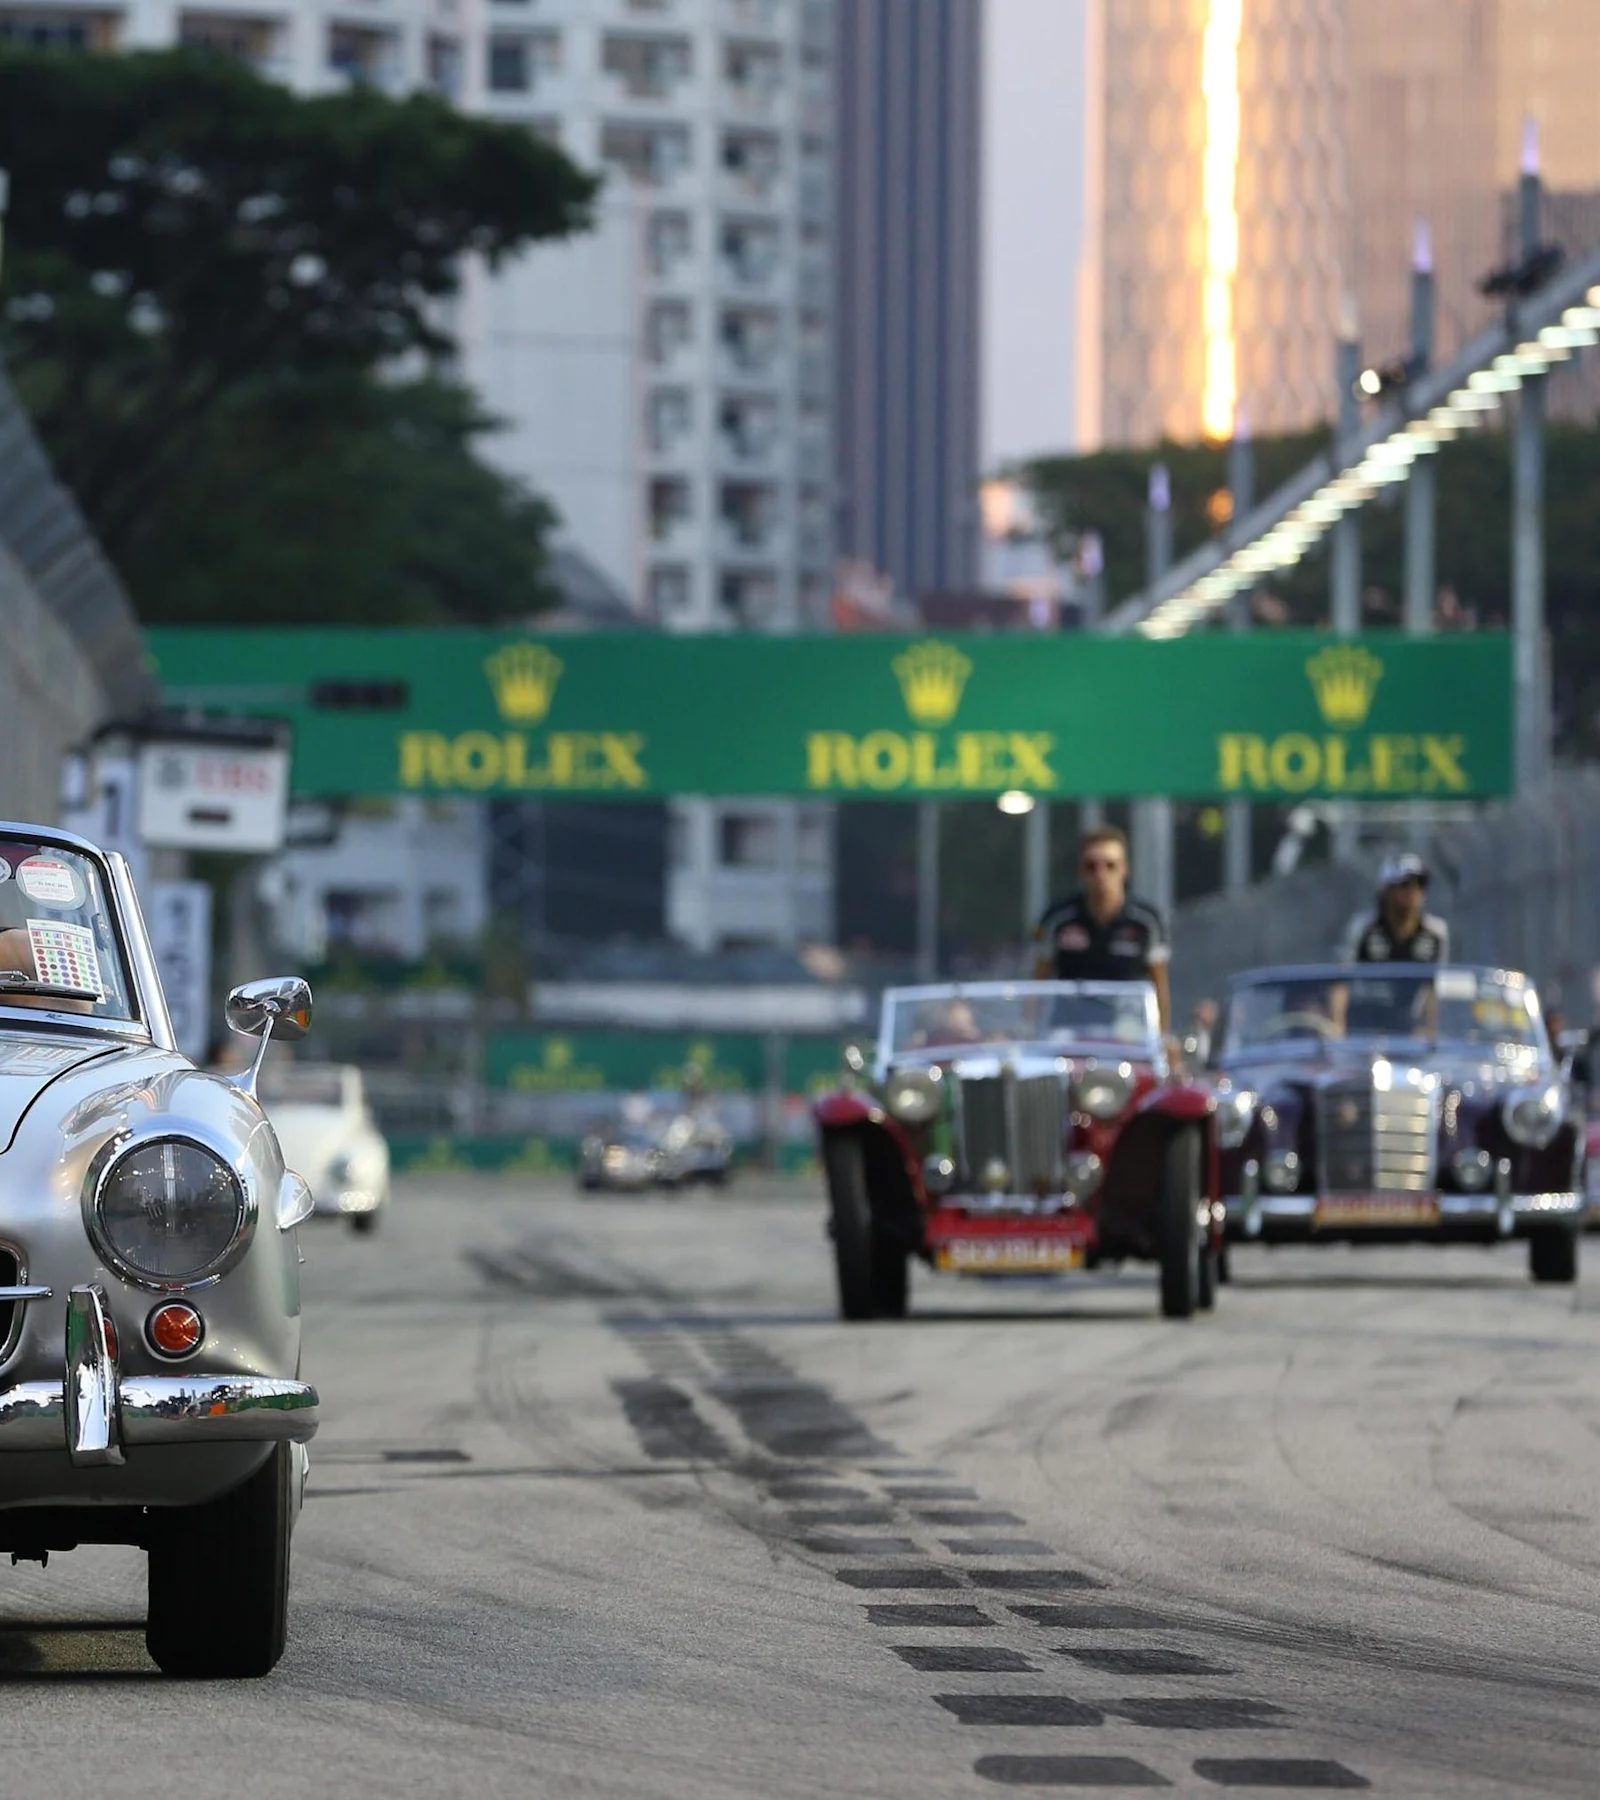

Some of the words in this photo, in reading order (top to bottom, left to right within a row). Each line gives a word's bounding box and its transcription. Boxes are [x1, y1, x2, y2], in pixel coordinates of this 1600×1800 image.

[401, 732, 646, 790] ROLEX
[807, 732, 1056, 789] ROLEX
[1218, 734, 1466, 791] ROLEX
